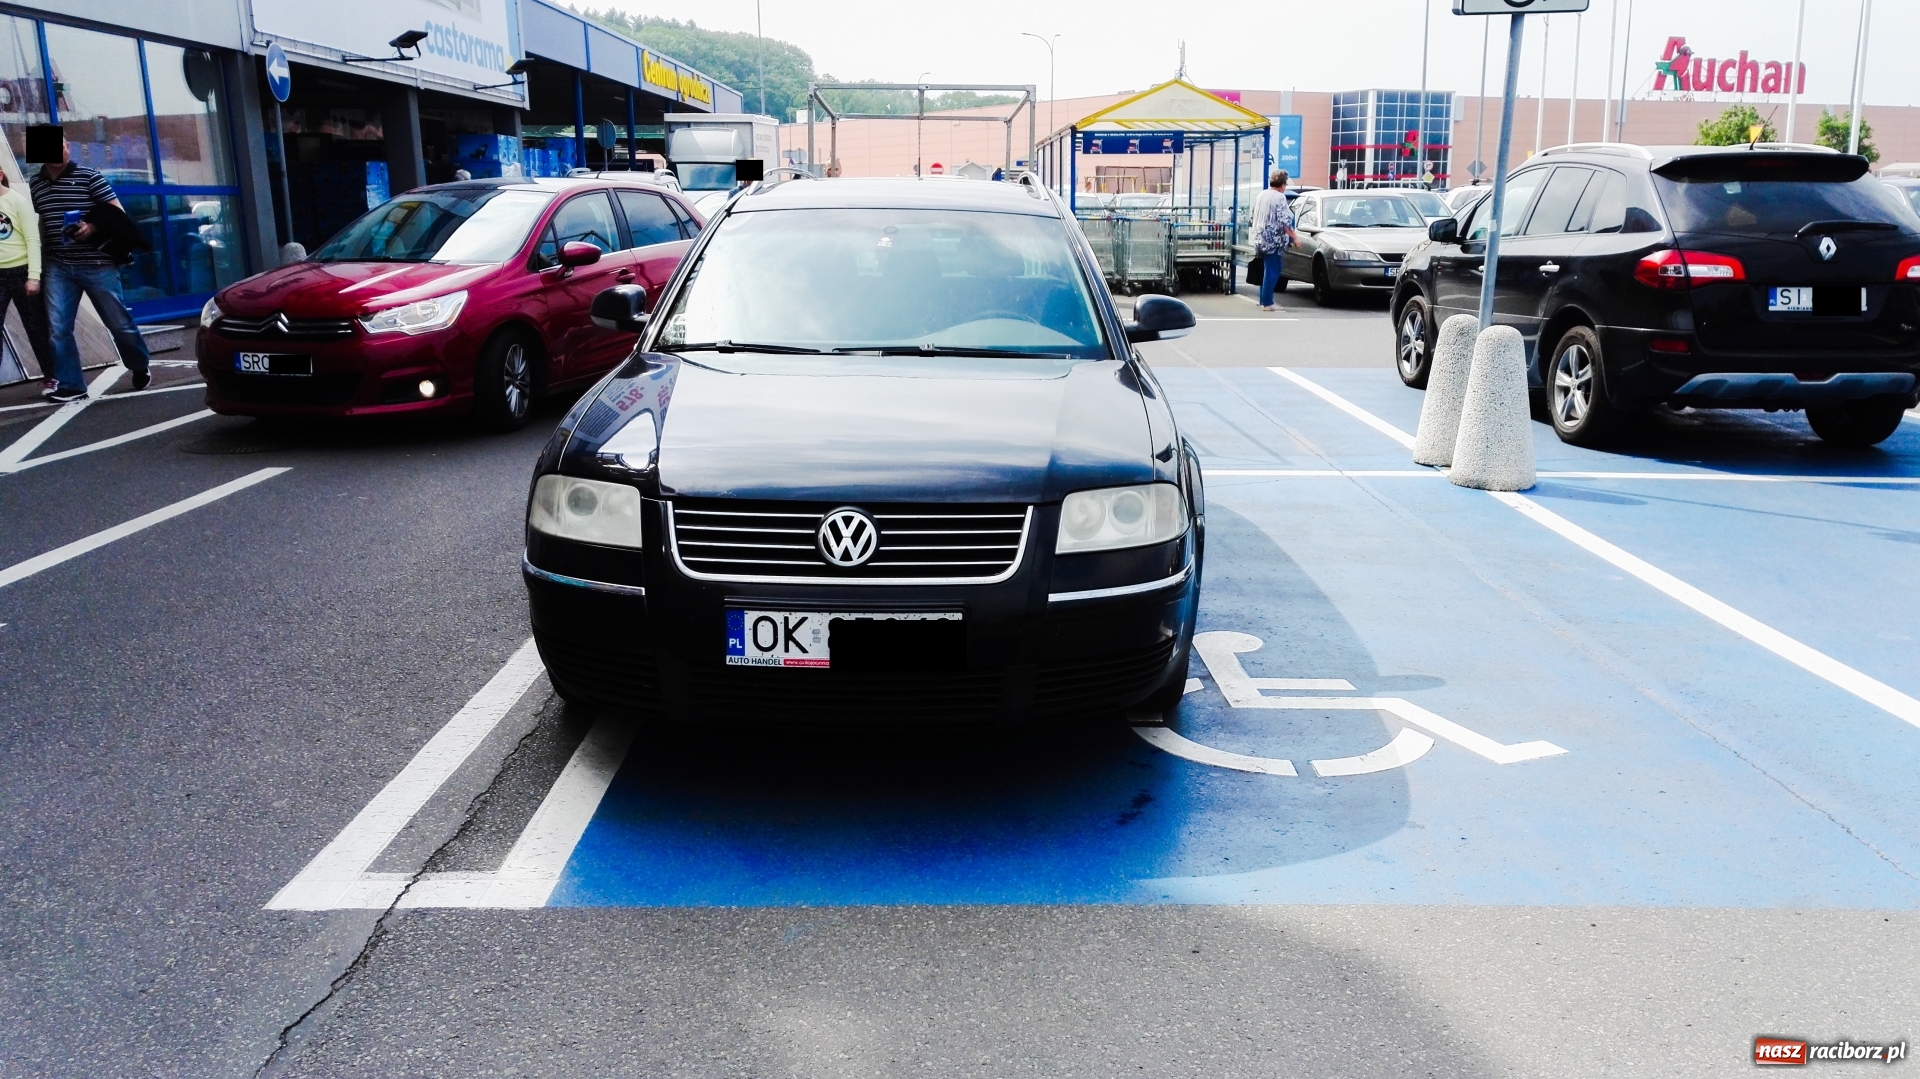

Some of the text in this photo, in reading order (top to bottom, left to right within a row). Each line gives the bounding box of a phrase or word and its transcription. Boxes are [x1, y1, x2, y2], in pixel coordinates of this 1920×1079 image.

[425, 20, 505, 73] castorama
[1652, 36, 1806, 94] Auchan
[641, 49, 678, 91] Centrum
[1780, 289, 1801, 305] SI
[729, 638, 742, 649] PL
[752, 615, 809, 654] OK
[728, 656, 750, 664] AUTO
[751, 658, 782, 666] HANDEL
